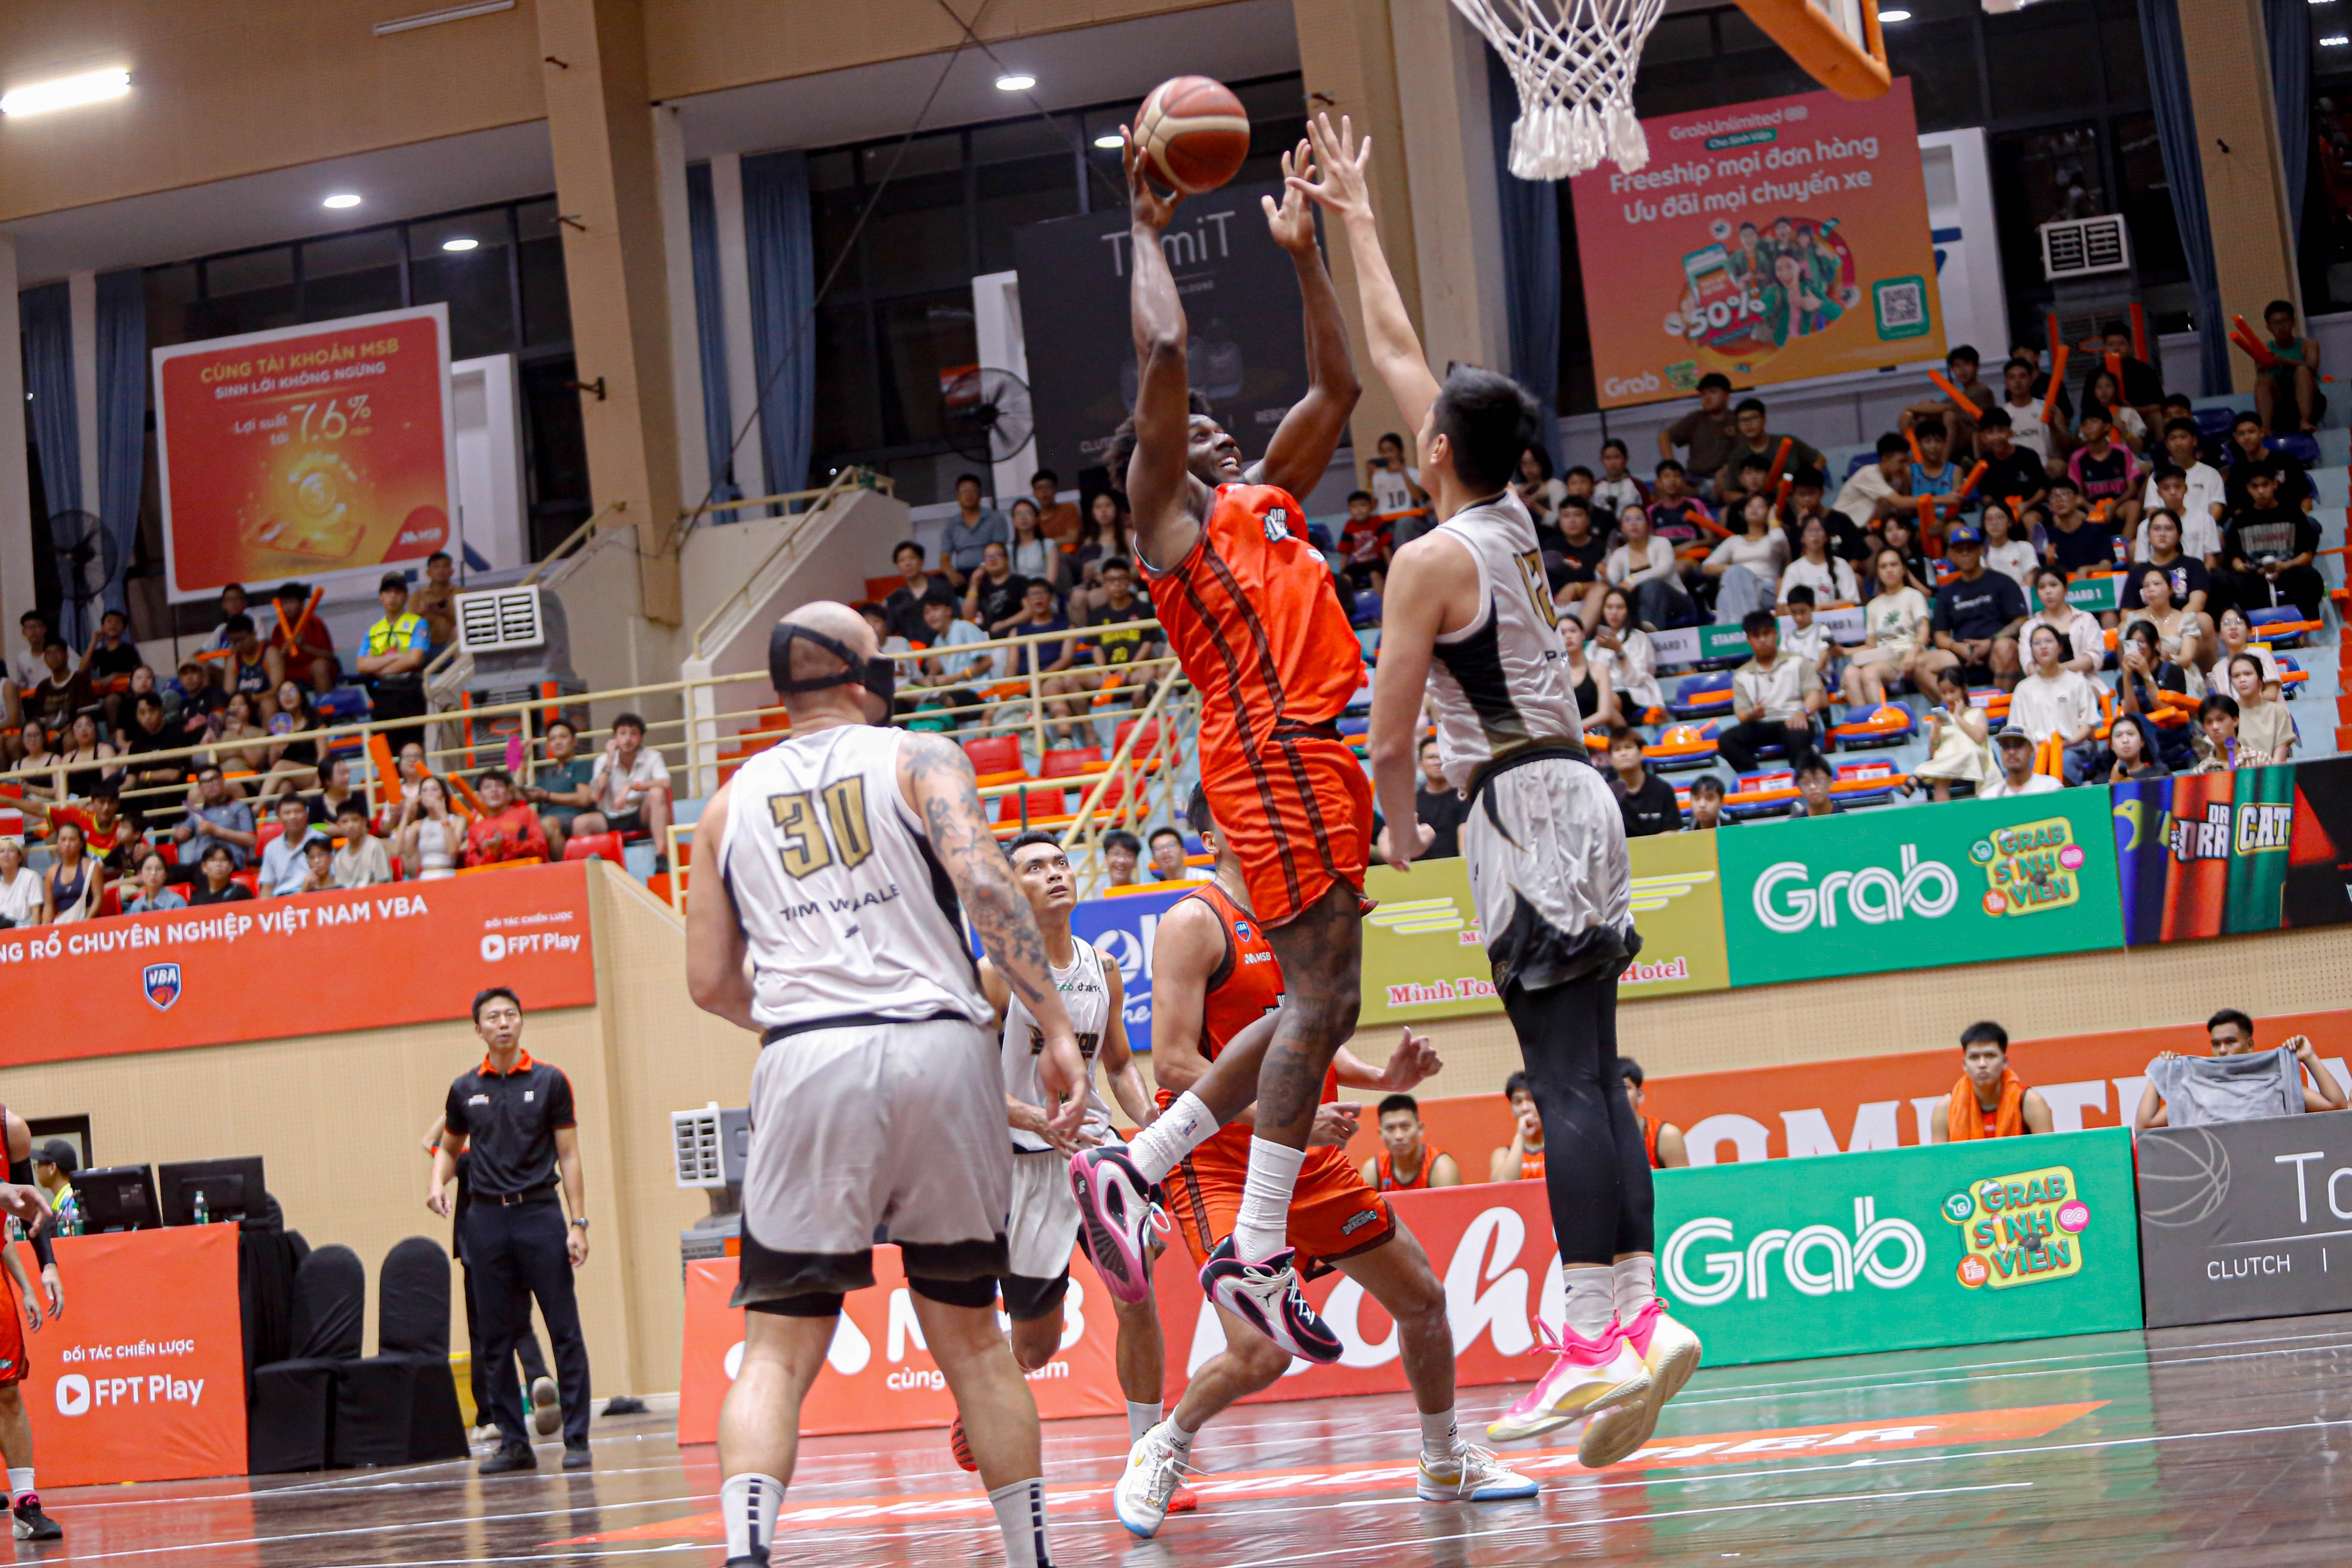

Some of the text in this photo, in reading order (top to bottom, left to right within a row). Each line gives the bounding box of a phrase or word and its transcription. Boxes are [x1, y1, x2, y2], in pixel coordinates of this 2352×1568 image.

[1669, 109, 1782, 141] GrabUnlimited
[1718, 151, 1761, 178] mọi
[1765, 146, 1812, 169] đơn
[1816, 136, 1878, 161] hàng
[1624, 169, 1872, 224] Ưu đãi mọi chuyến xe
[1101, 211, 1236, 276] TmiT
[1689, 291, 1766, 339] 50%
[200, 337, 399, 384] CÙNG TÀI KHOẢN MSB
[215, 383, 248, 399] SINH
[279, 369, 330, 389] KHÔNG
[1604, 371, 1660, 397] Grab
[767, 774, 873, 881] 30
[1998, 824, 2066, 855] GRAB
[2239, 806, 2291, 851] CAT
[1994, 851, 2056, 885] SINH
[1752, 843, 1959, 934] Grab
[31, 929, 62, 960] RỔ
[68, 922, 160, 955] CHUYÊN
[167, 912, 253, 943] NGHIỆP
[259, 905, 310, 936] VIỆT
[316, 901, 371, 927] NAM
[377, 894, 428, 919] VBA
[503, 915, 519, 927] TÁC
[521, 913, 548, 925] CHIẾN
[550, 911, 574, 923] LƯỢC
[780, 901, 820, 921] TIM
[508, 932, 581, 954] FPT Play
[1256, 952, 1271, 962] MSB
[149, 967, 177, 986] VBA
[1388, 980, 1455, 1005] Minh
[1620, 958, 1687, 982] Hotel
[1980, 1174, 2067, 1213] GRAB
[1974, 1207, 2053, 1253] SINH
[1662, 1195, 1927, 1306] Grab
[2207, 1254, 2291, 1280] CLUTCH
[63, 1339, 194, 1363] ĐỐI TÁC CHIẾN LƯỢC
[95, 1374, 205, 1406] FPT Play
[886, 1367, 946, 1391] cùng
